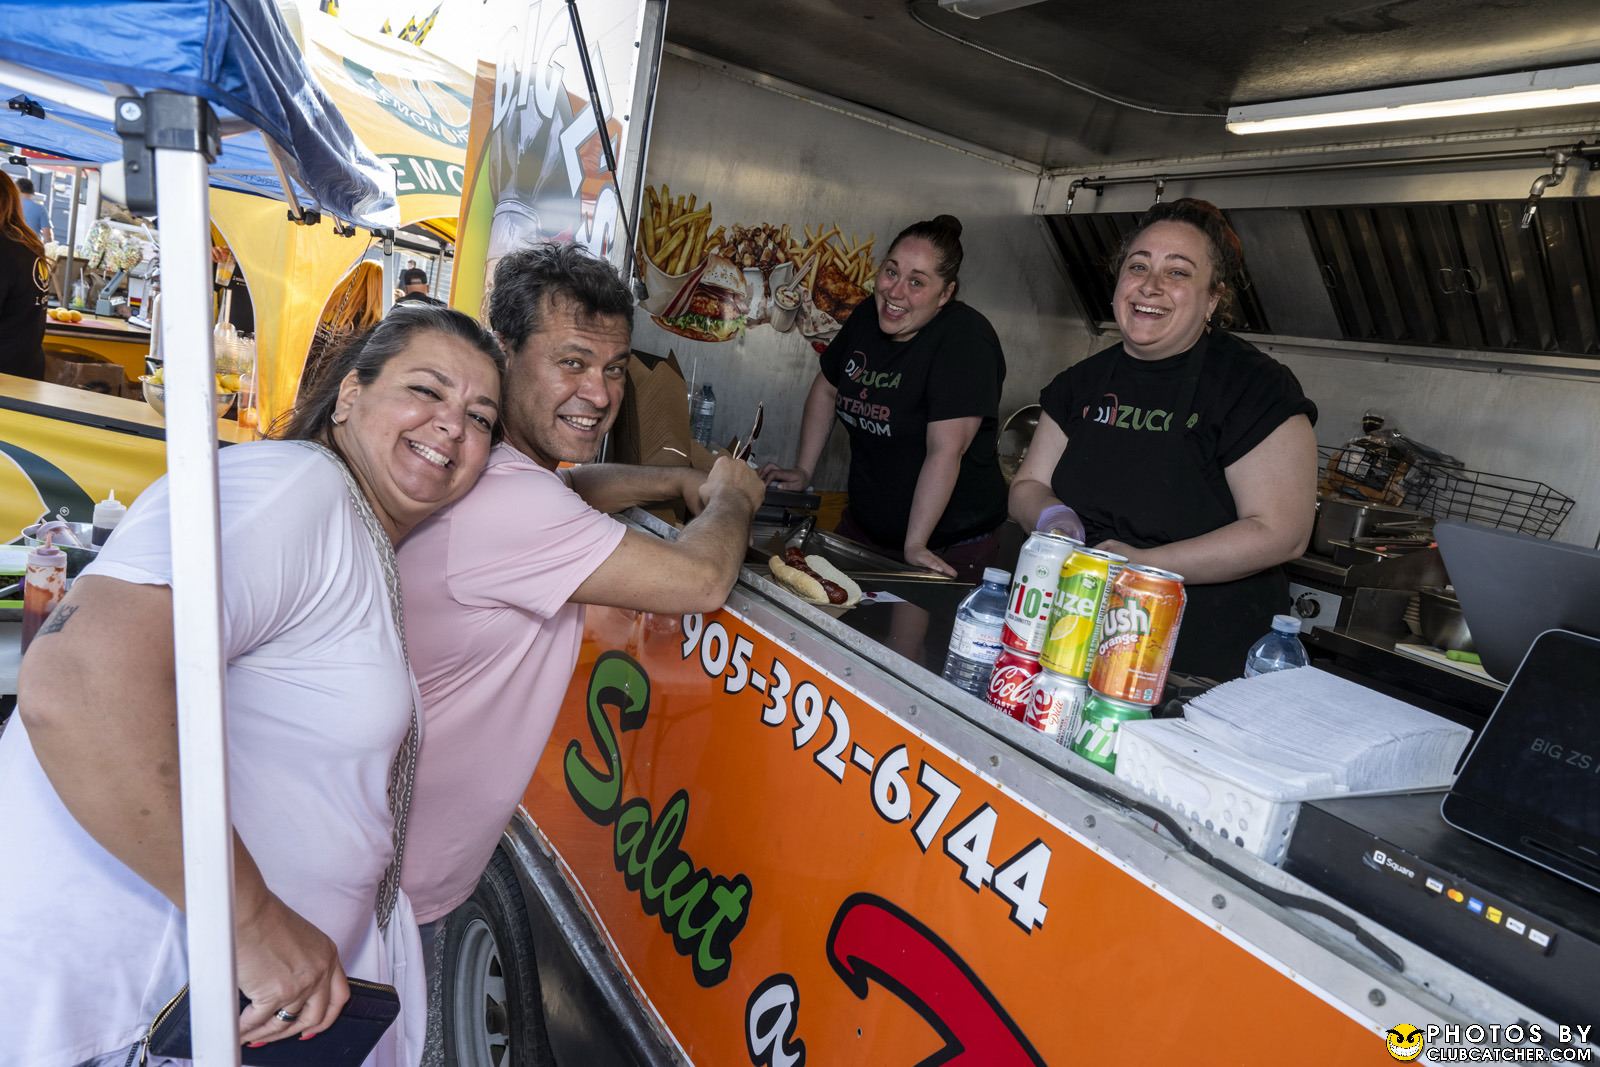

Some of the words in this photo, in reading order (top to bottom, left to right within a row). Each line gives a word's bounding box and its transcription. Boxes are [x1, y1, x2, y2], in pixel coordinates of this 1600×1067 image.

[493, 0, 570, 131] BIG
[859, 417, 892, 437] DOM
[681, 612, 1053, 936] 905-392-6744
[1530, 737, 1564, 760] BIG
[1565, 749, 1593, 769] ZS
[564, 650, 753, 988] Salut
[1386, 857, 1415, 879] Square
